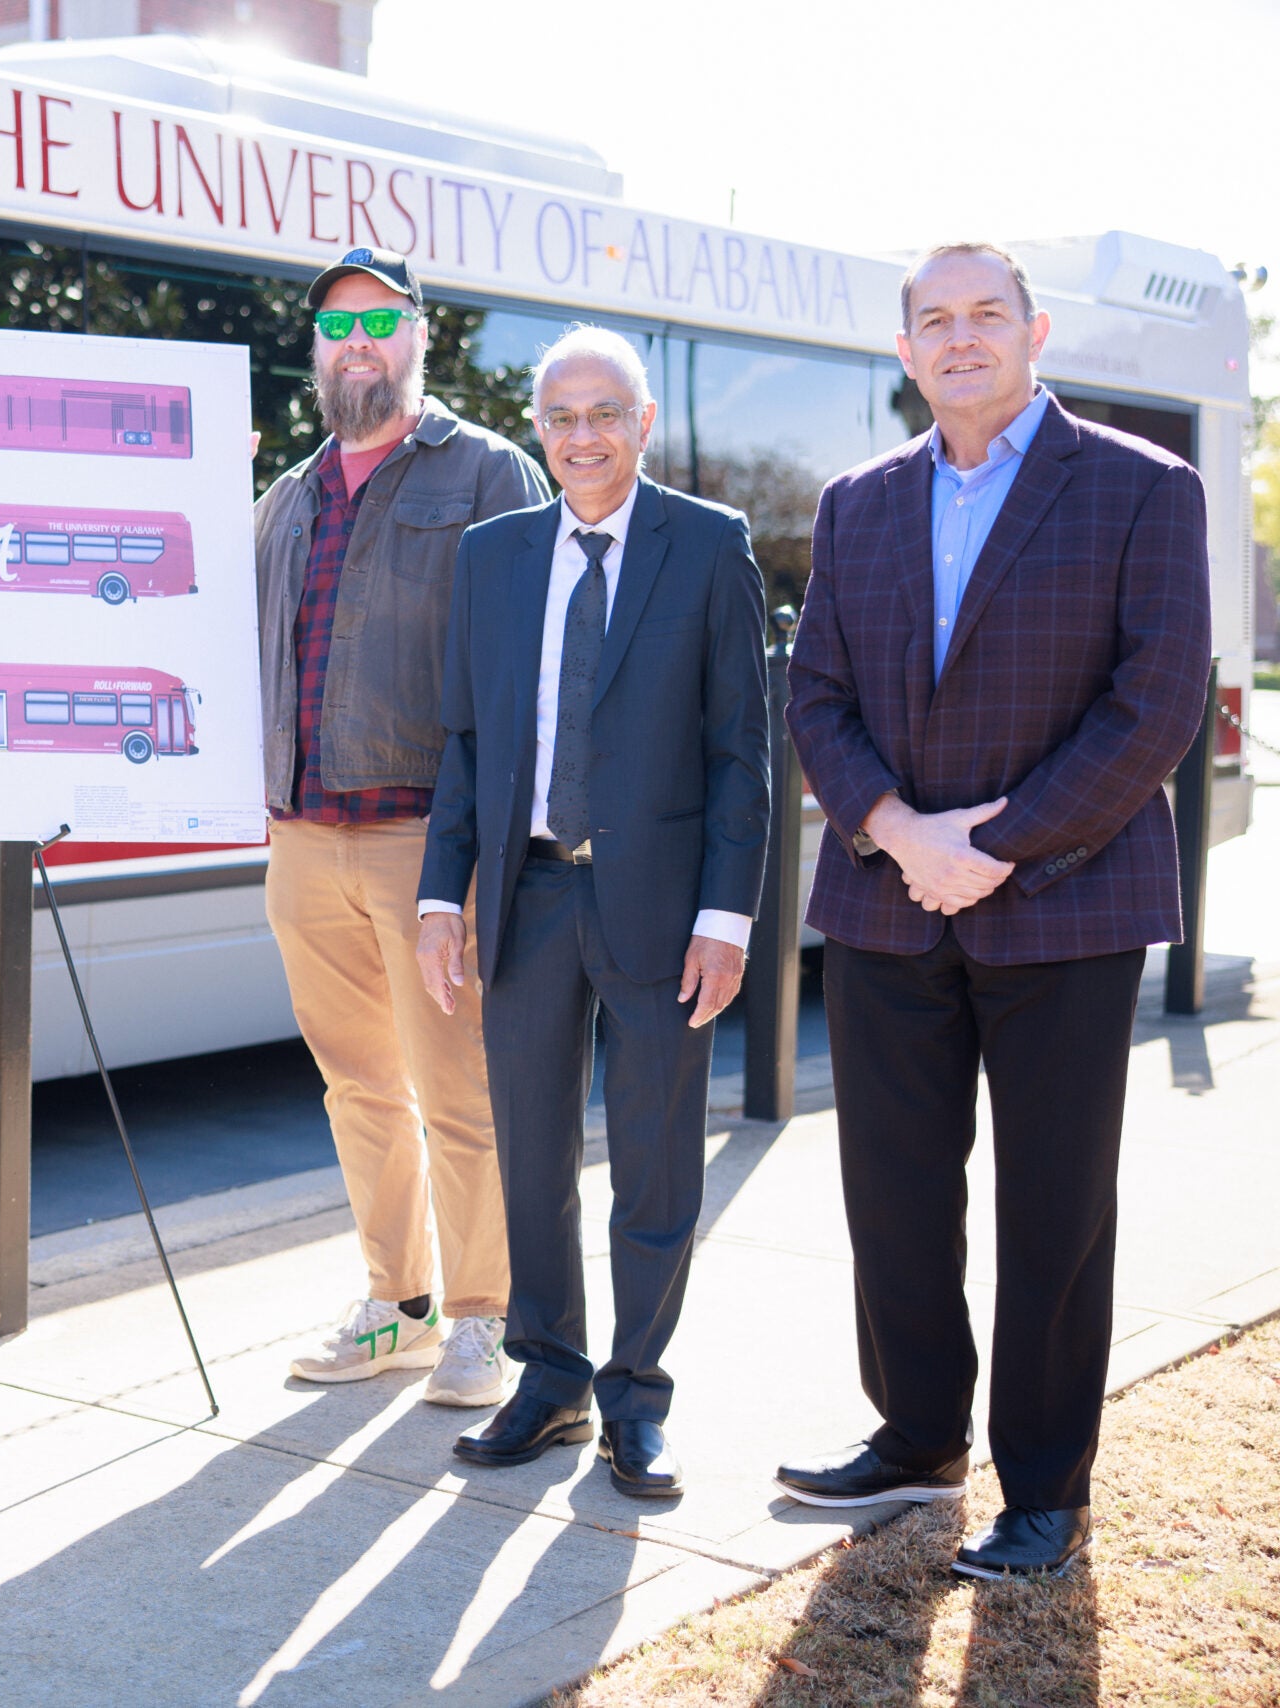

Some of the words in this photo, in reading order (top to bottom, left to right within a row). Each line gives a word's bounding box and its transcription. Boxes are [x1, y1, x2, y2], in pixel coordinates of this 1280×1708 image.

[112, 111, 514, 272] UNIVERSITY
[536, 201, 604, 288] OF
[623, 219, 858, 330] ALABAMA
[48, 522, 64, 531] THE
[65, 523, 109, 533] UNIVERSITY
[110, 525, 121, 534] OF
[94, 680, 114, 691] ROLL
[116, 681, 153, 692] FORWARD
